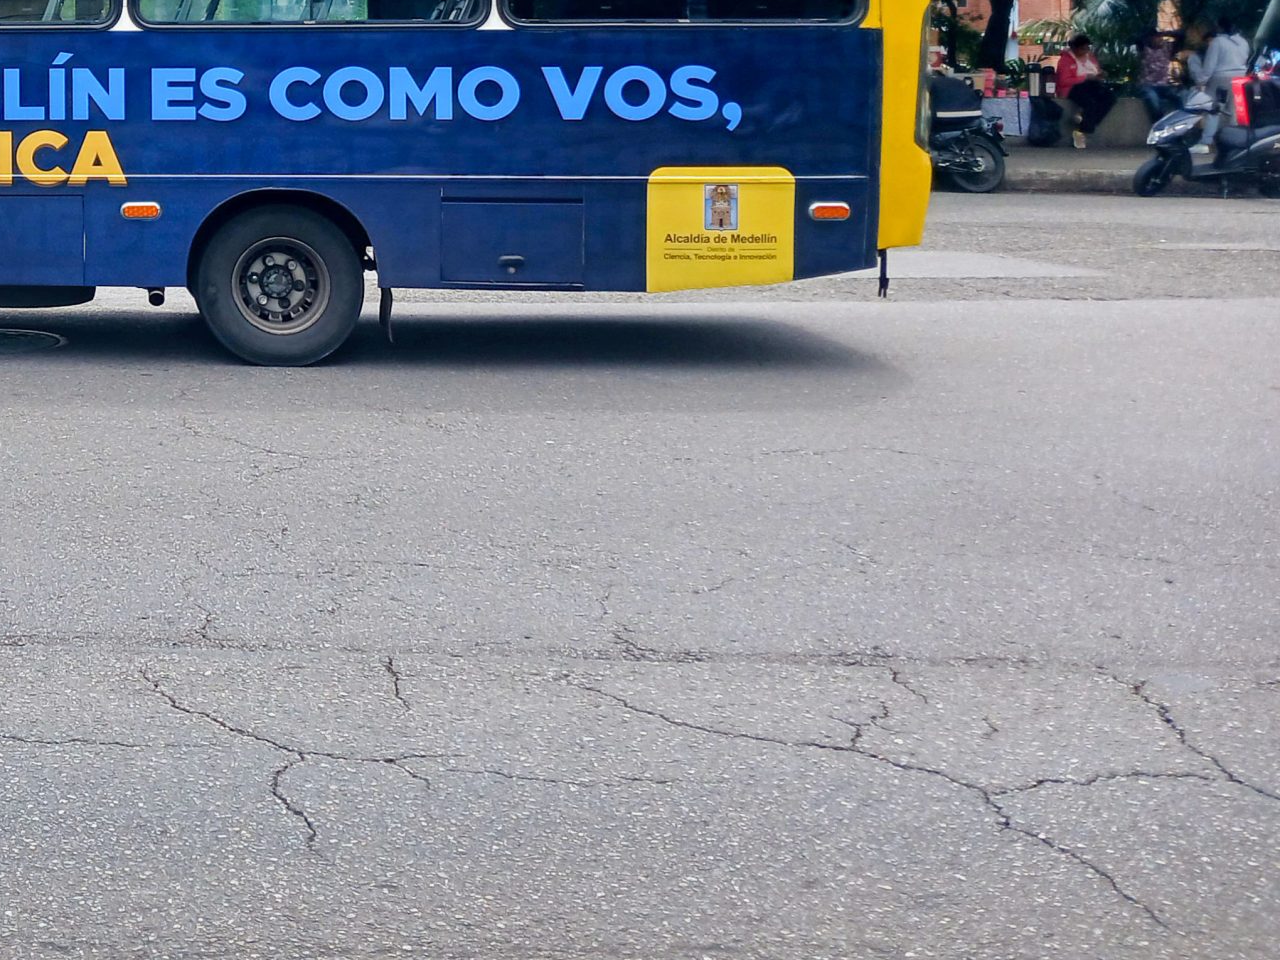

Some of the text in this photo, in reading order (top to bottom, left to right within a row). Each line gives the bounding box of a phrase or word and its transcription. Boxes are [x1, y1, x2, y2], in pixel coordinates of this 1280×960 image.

[151, 66, 247, 122] ES
[269, 65, 520, 121] COMO
[541, 65, 743, 132] VOS,
[713, 233, 727, 244] de
